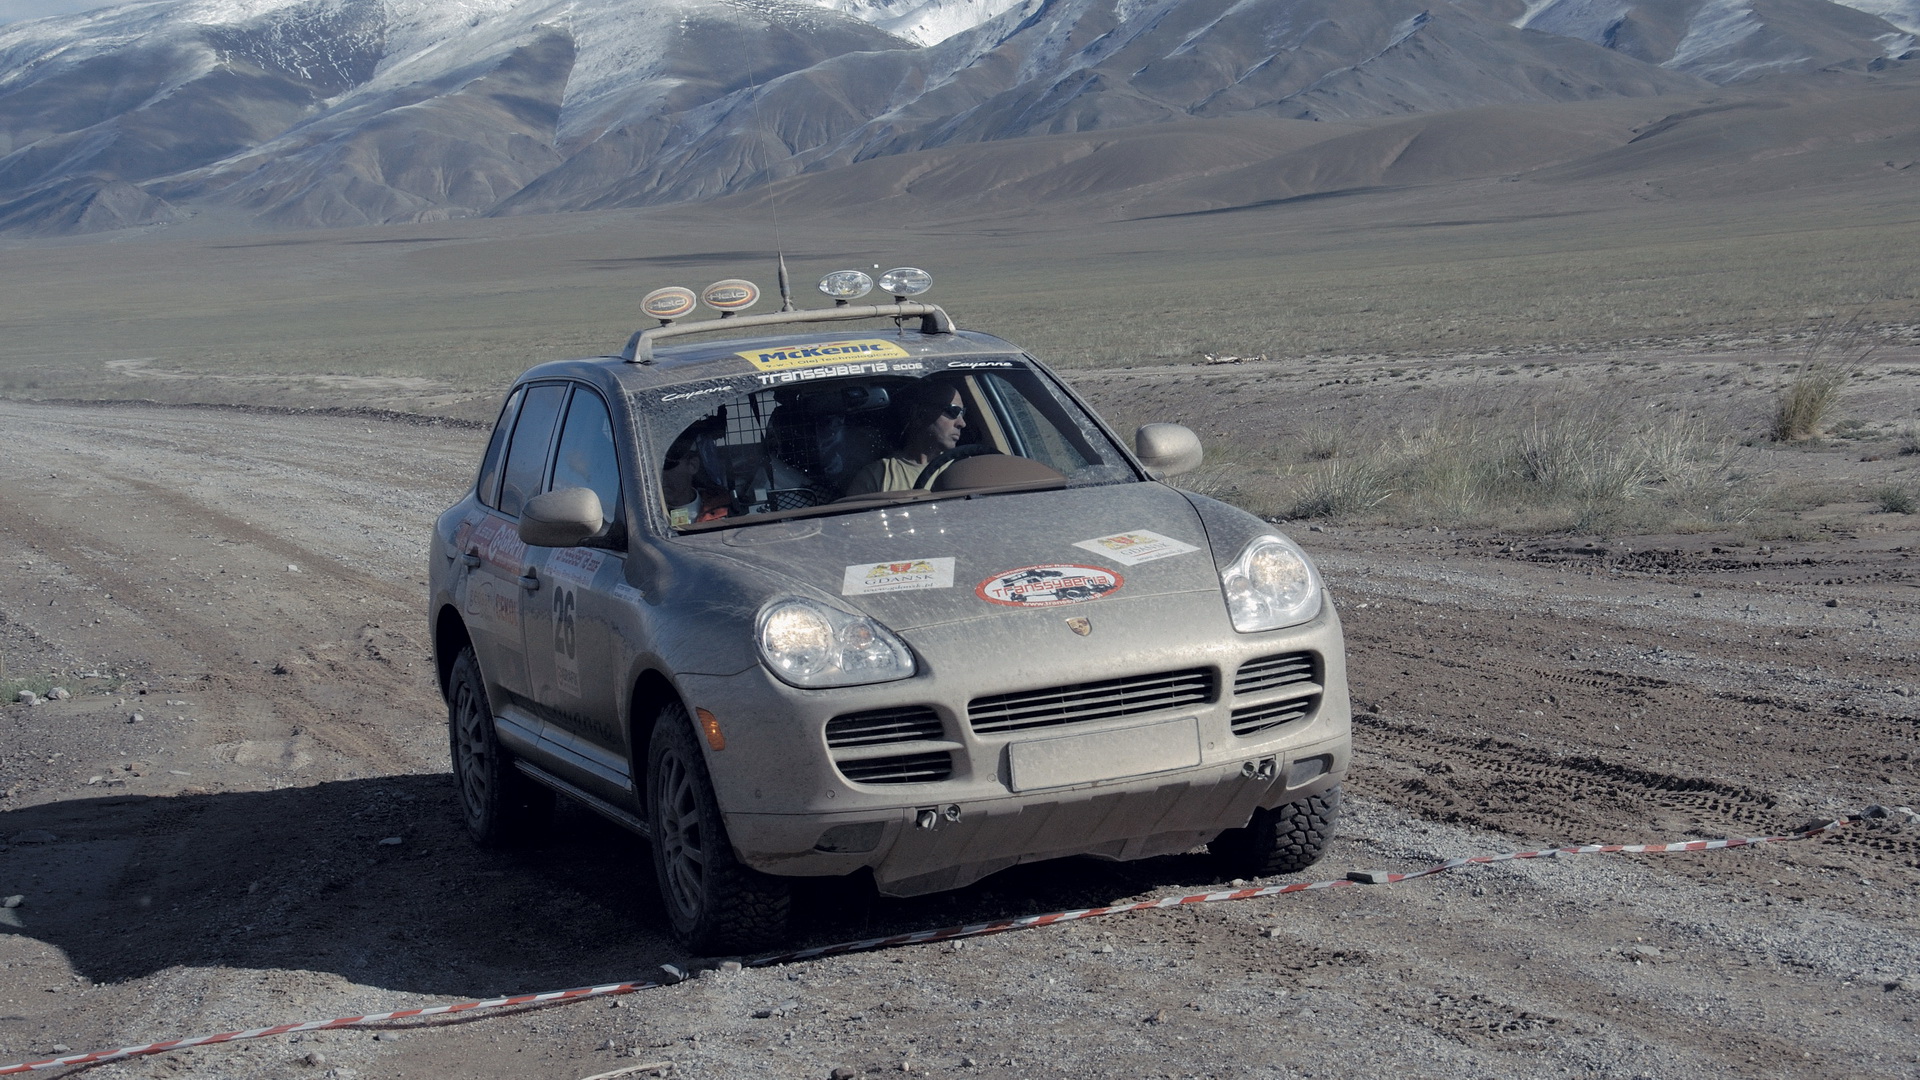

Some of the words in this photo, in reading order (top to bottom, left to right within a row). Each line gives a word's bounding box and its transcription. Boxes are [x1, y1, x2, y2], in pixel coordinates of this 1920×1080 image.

[758, 343, 885, 363] McKenic
[758, 363, 888, 385] Transsyberia
[893, 362, 922, 371] 2006
[948, 361, 1013, 370] Cayenne
[661, 385, 733, 401] Cayenne
[992, 575, 1109, 598] Transsyberia
[554, 585, 576, 660] 26
